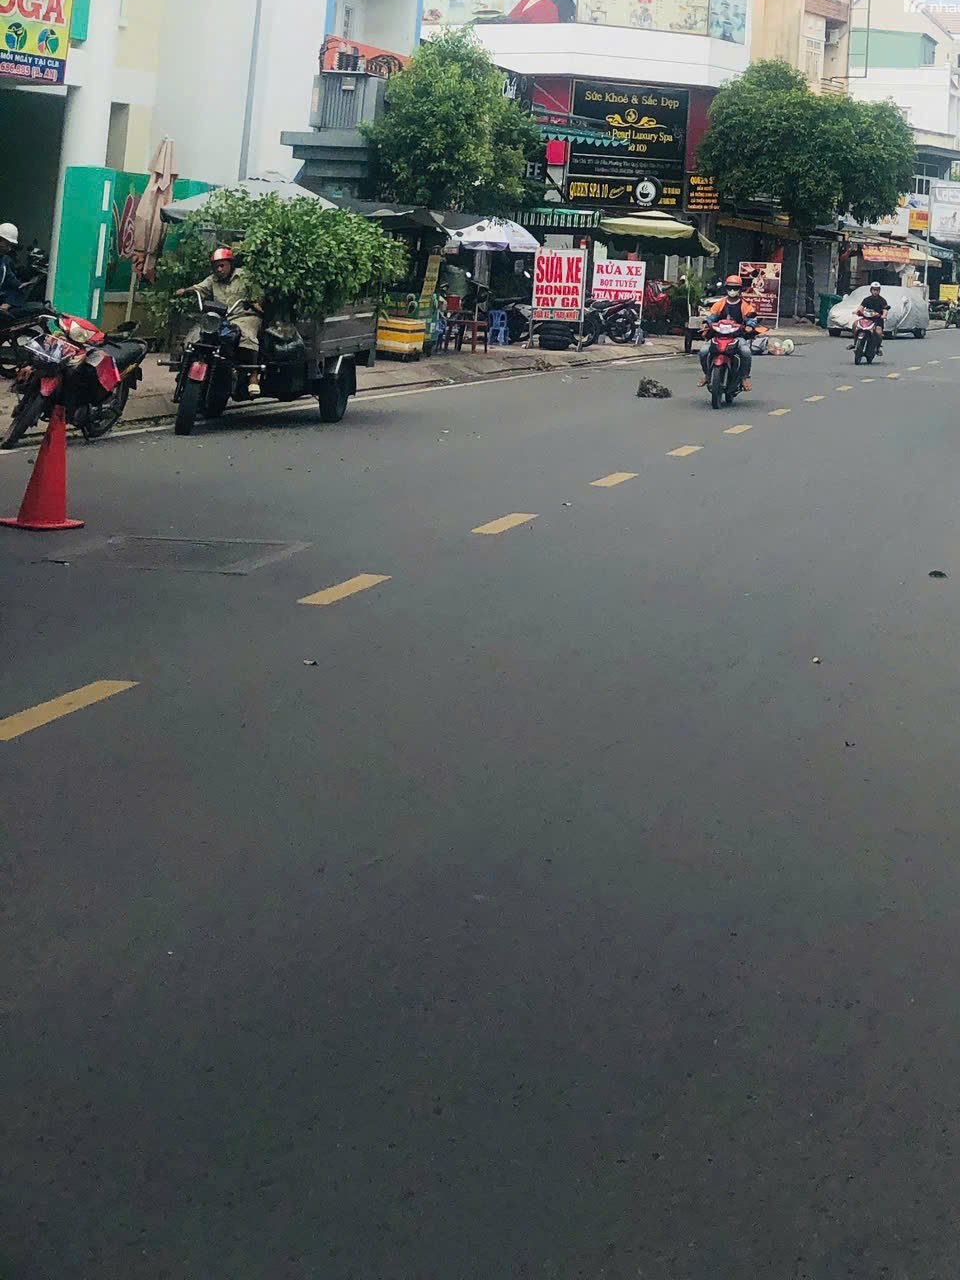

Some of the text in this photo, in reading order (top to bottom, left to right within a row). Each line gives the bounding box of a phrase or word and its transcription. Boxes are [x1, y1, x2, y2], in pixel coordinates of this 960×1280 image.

[585, 90, 603, 101] Sức
[631, 96, 639, 105] &
[642, 93, 658, 106] Sắc
[660, 98, 680, 109] Đẹp
[612, 128, 673, 144] Pearl Luxury Spa
[569, 182, 588, 200] QUEEN
[589, 182, 600, 197] SPA
[601, 183, 609, 198] 10
[536, 252, 583, 284] SỬA XE
[596, 261, 642, 276] RỬA XE
[535, 285, 580, 296] HONDA
[600, 277, 638, 289] BỌT TUYẾT
[535, 296, 580, 308] TAY GA
[593, 290, 642, 301] THAY NHỚT
